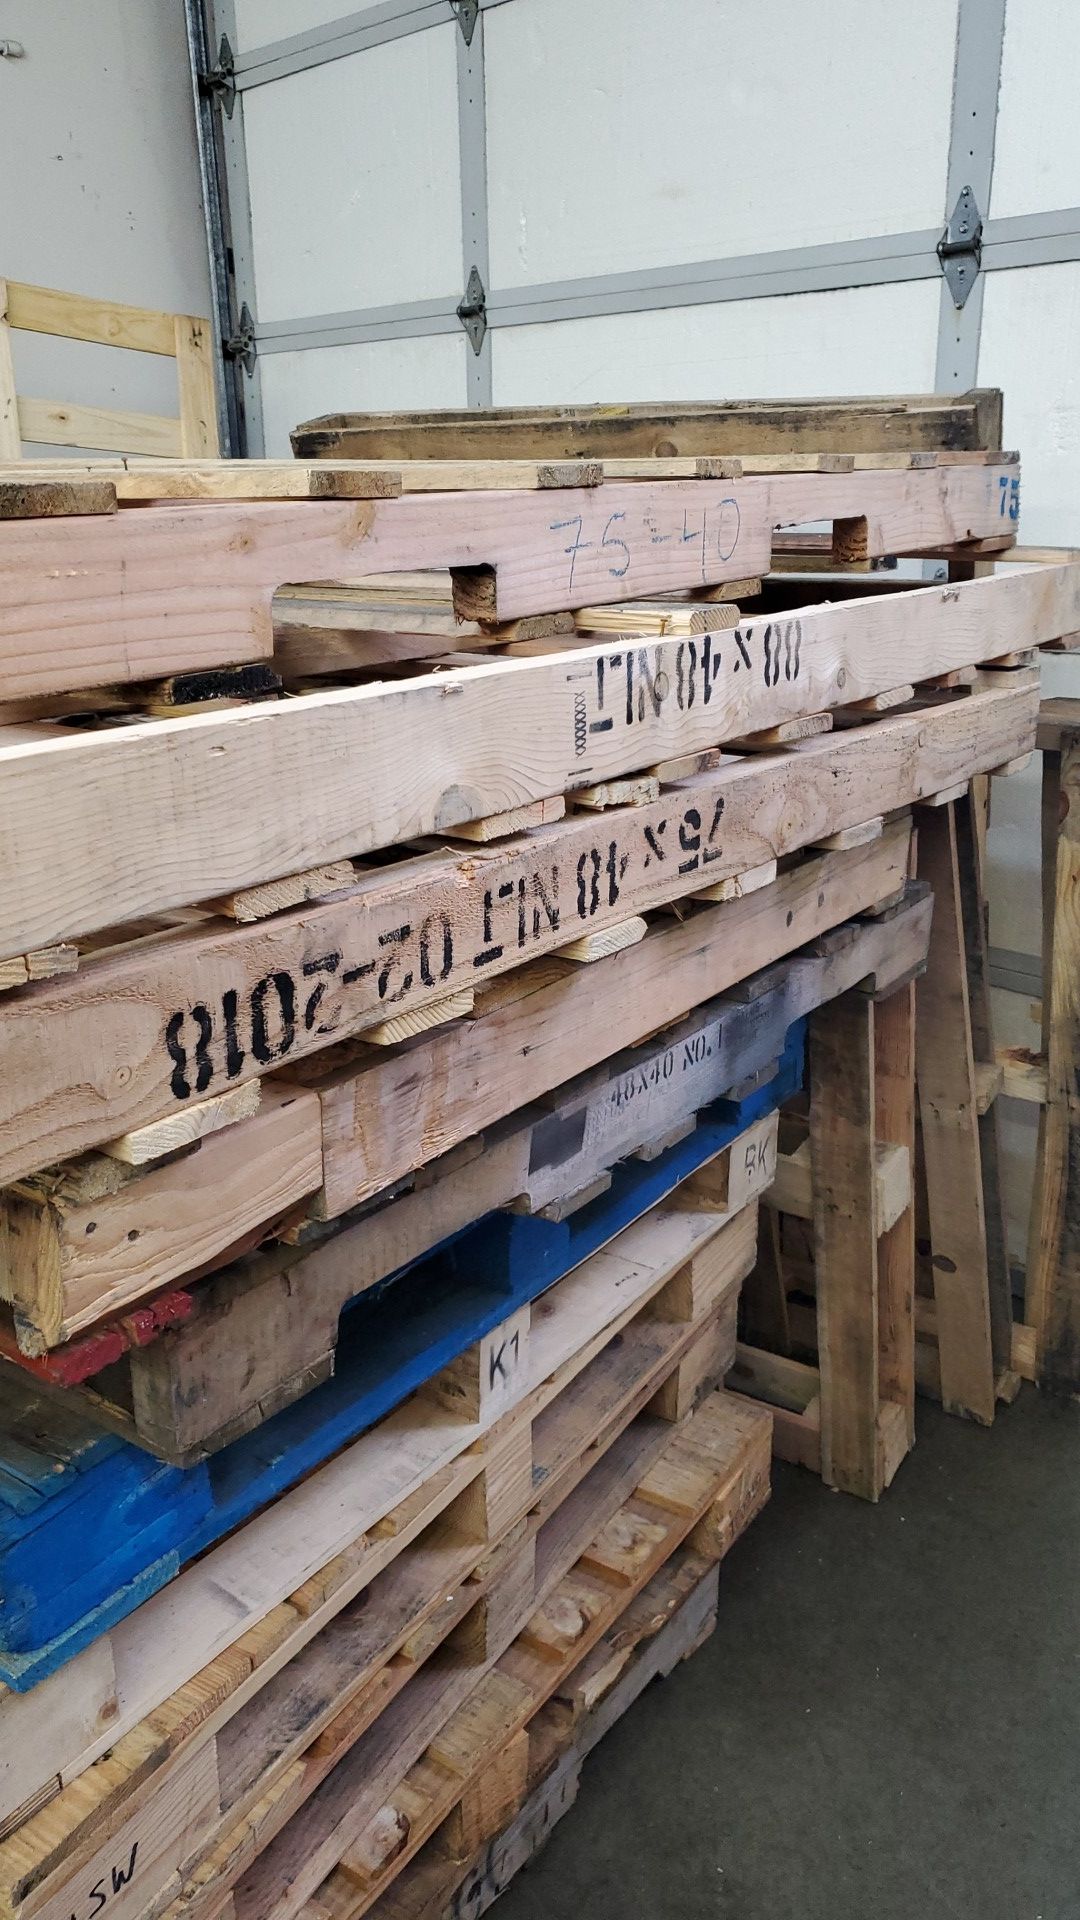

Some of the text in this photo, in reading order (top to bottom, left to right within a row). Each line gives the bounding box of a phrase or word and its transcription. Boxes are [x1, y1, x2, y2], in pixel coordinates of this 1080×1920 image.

[999, 476, 1020, 520] 75
[678, 797, 725, 875] 75
[576, 840, 629, 920] 48
[165, 912, 454, 1101] 02-2018
[489, 1329, 520, 1393] K1
